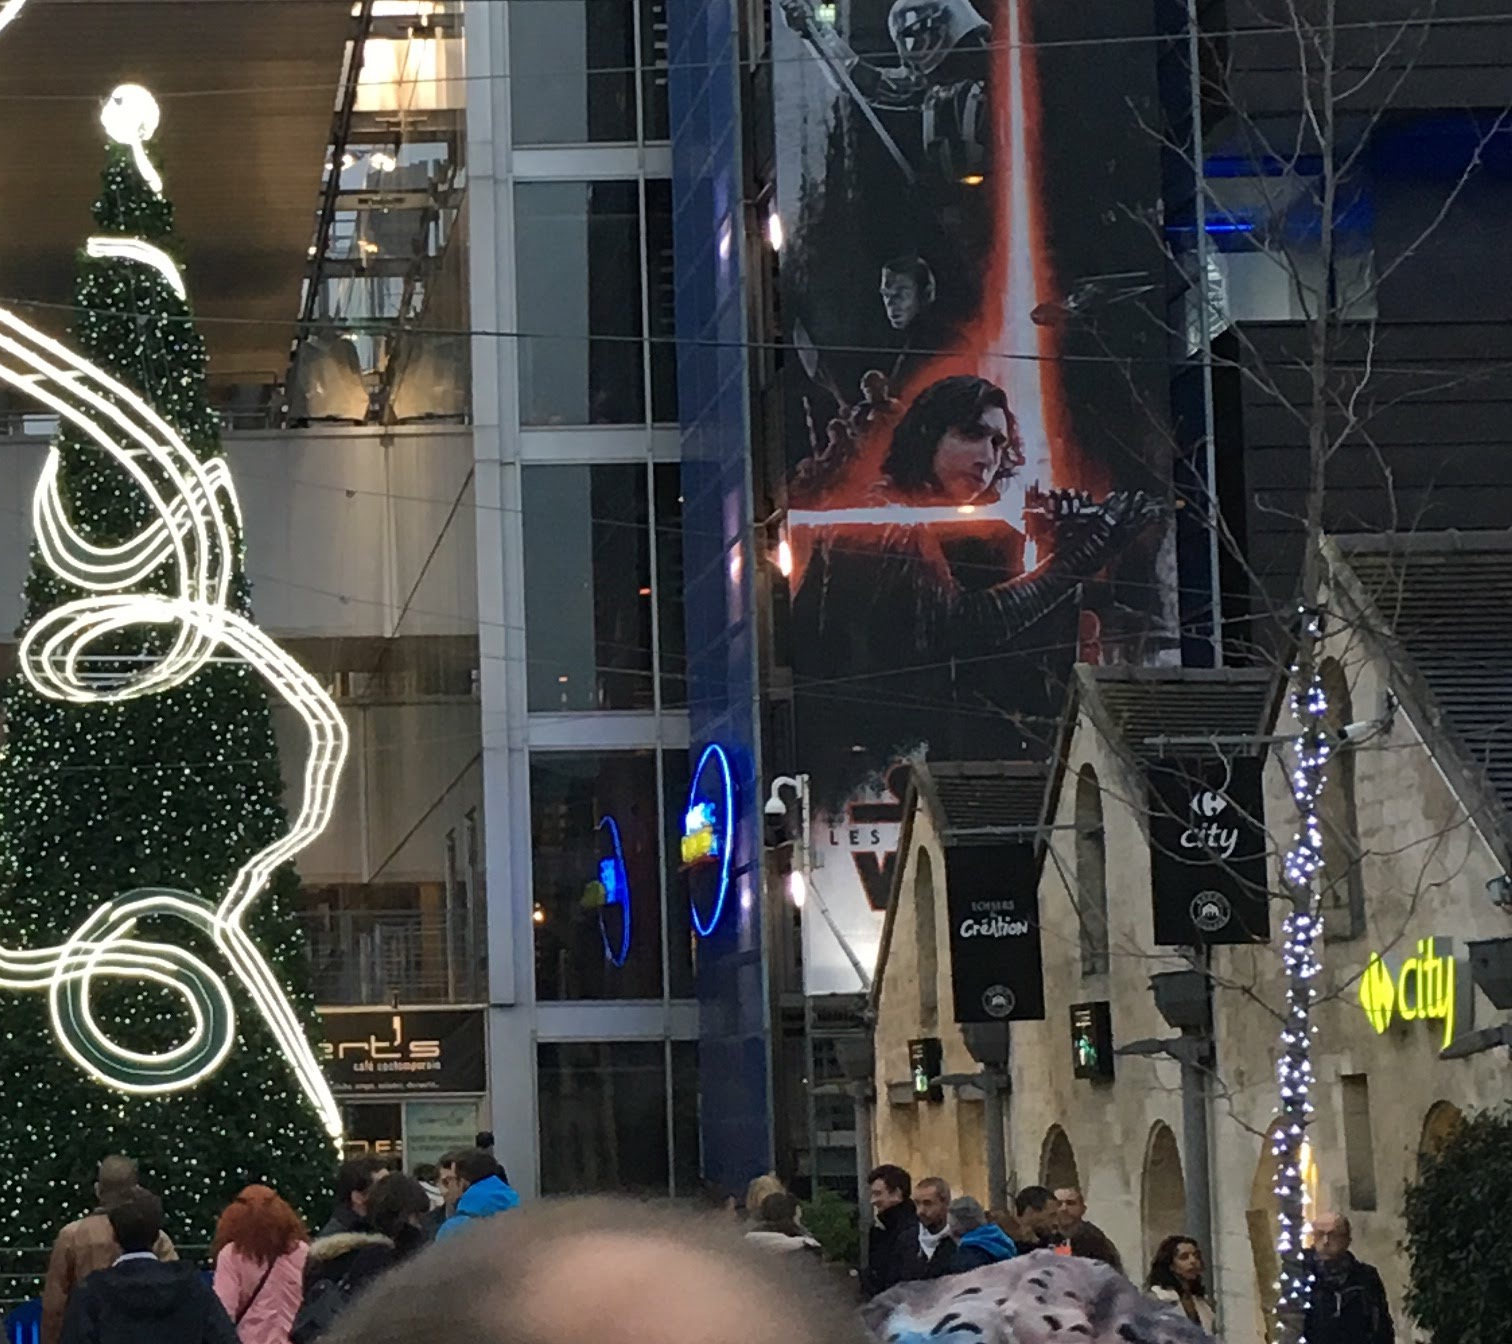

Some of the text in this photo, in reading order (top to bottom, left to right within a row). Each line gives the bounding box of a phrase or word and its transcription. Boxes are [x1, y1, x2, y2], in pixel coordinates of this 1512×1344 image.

[829, 829, 880, 846] LES
[1180, 822, 1239, 859] city
[1398, 936, 1454, 1052] city
